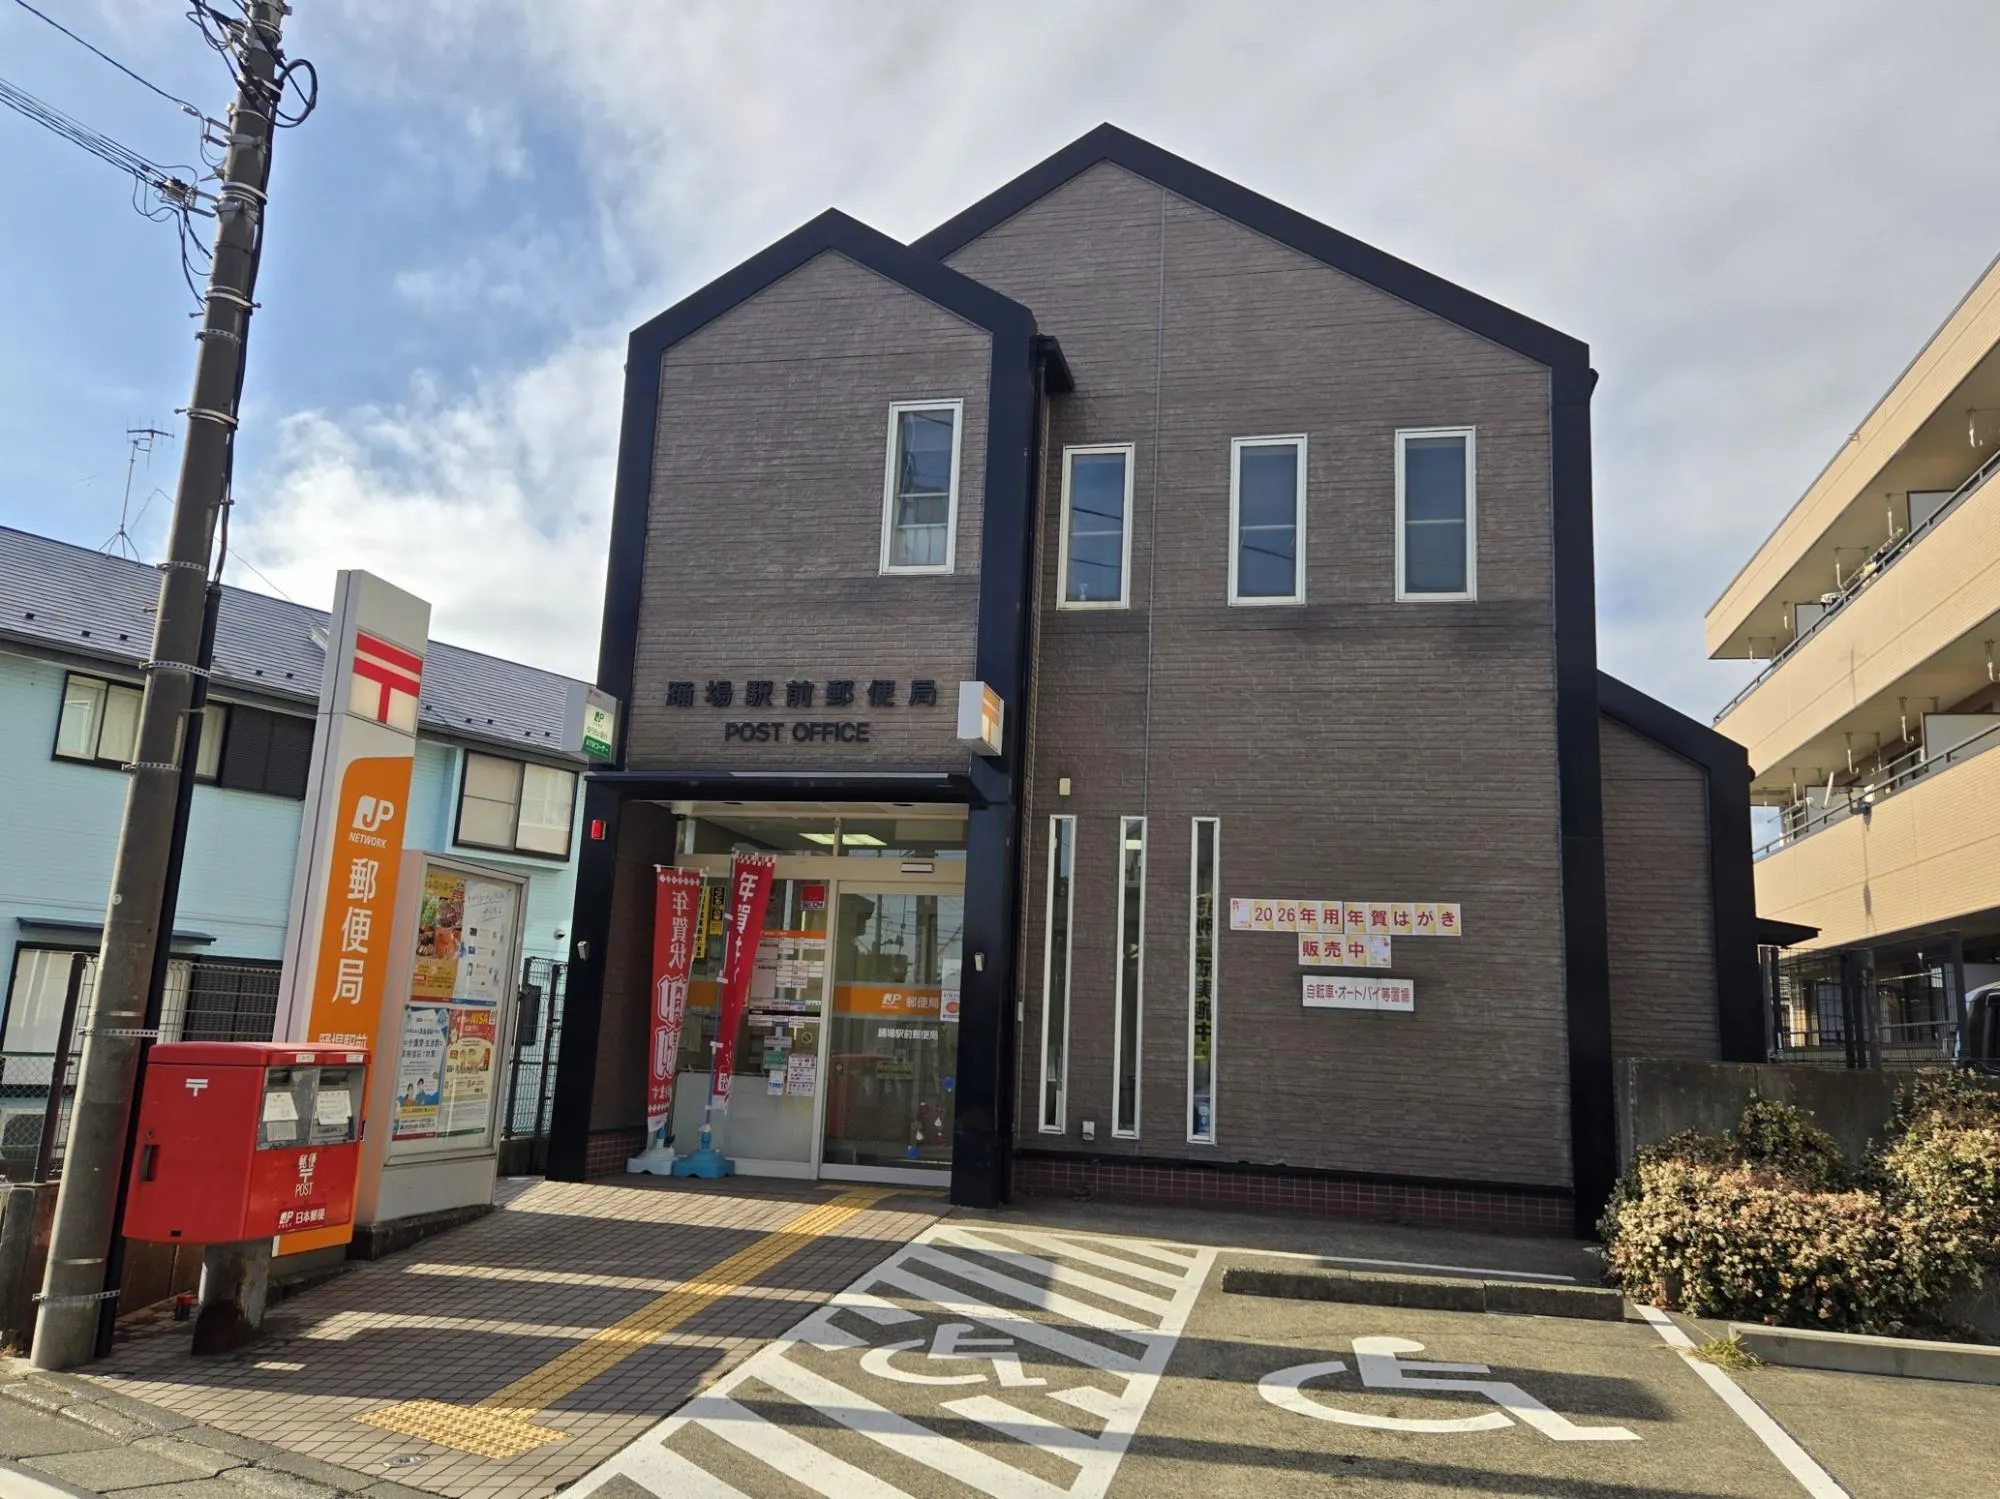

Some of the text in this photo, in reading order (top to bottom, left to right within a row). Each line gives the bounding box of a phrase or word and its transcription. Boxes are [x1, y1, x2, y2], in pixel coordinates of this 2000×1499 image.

[666, 679, 937, 708] 踊場駅前郵便局
[725, 722, 870, 743] POST OFFICE
[348, 832, 387, 849] NETWORK
[332, 858, 380, 1005] 郵便局
[1302, 940, 1365, 959] 販売中
[906, 995, 939, 1009] 郵便局
[470, 1012, 489, 1024] NISA
[298, 1152, 317, 1170] 郵便
[295, 1182, 314, 1197] POST
[295, 1207, 326, 1224] 日本郵便
